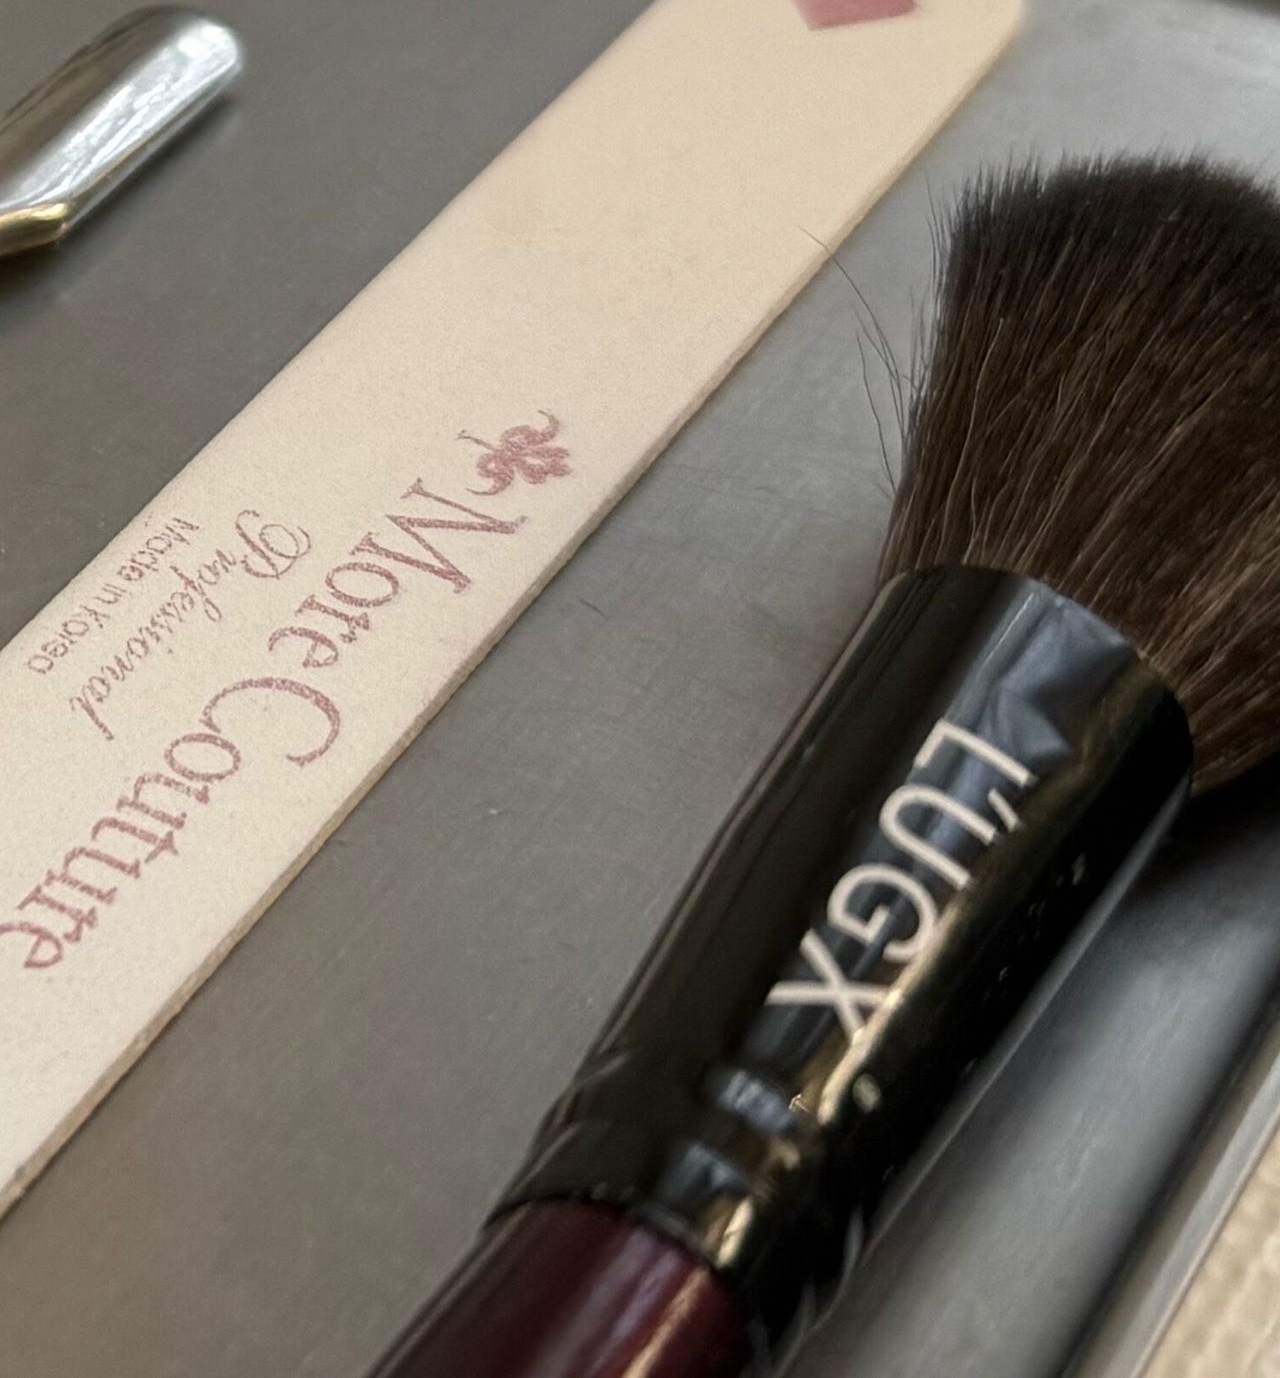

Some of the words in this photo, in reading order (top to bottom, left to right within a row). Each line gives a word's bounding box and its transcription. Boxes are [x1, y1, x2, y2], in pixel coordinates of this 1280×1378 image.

[117, 517, 199, 582] Made
[268, 478, 527, 668] More
[69, 509, 312, 740] Professional
[95, 582, 125, 606] in
[26, 603, 109, 675] Korea
